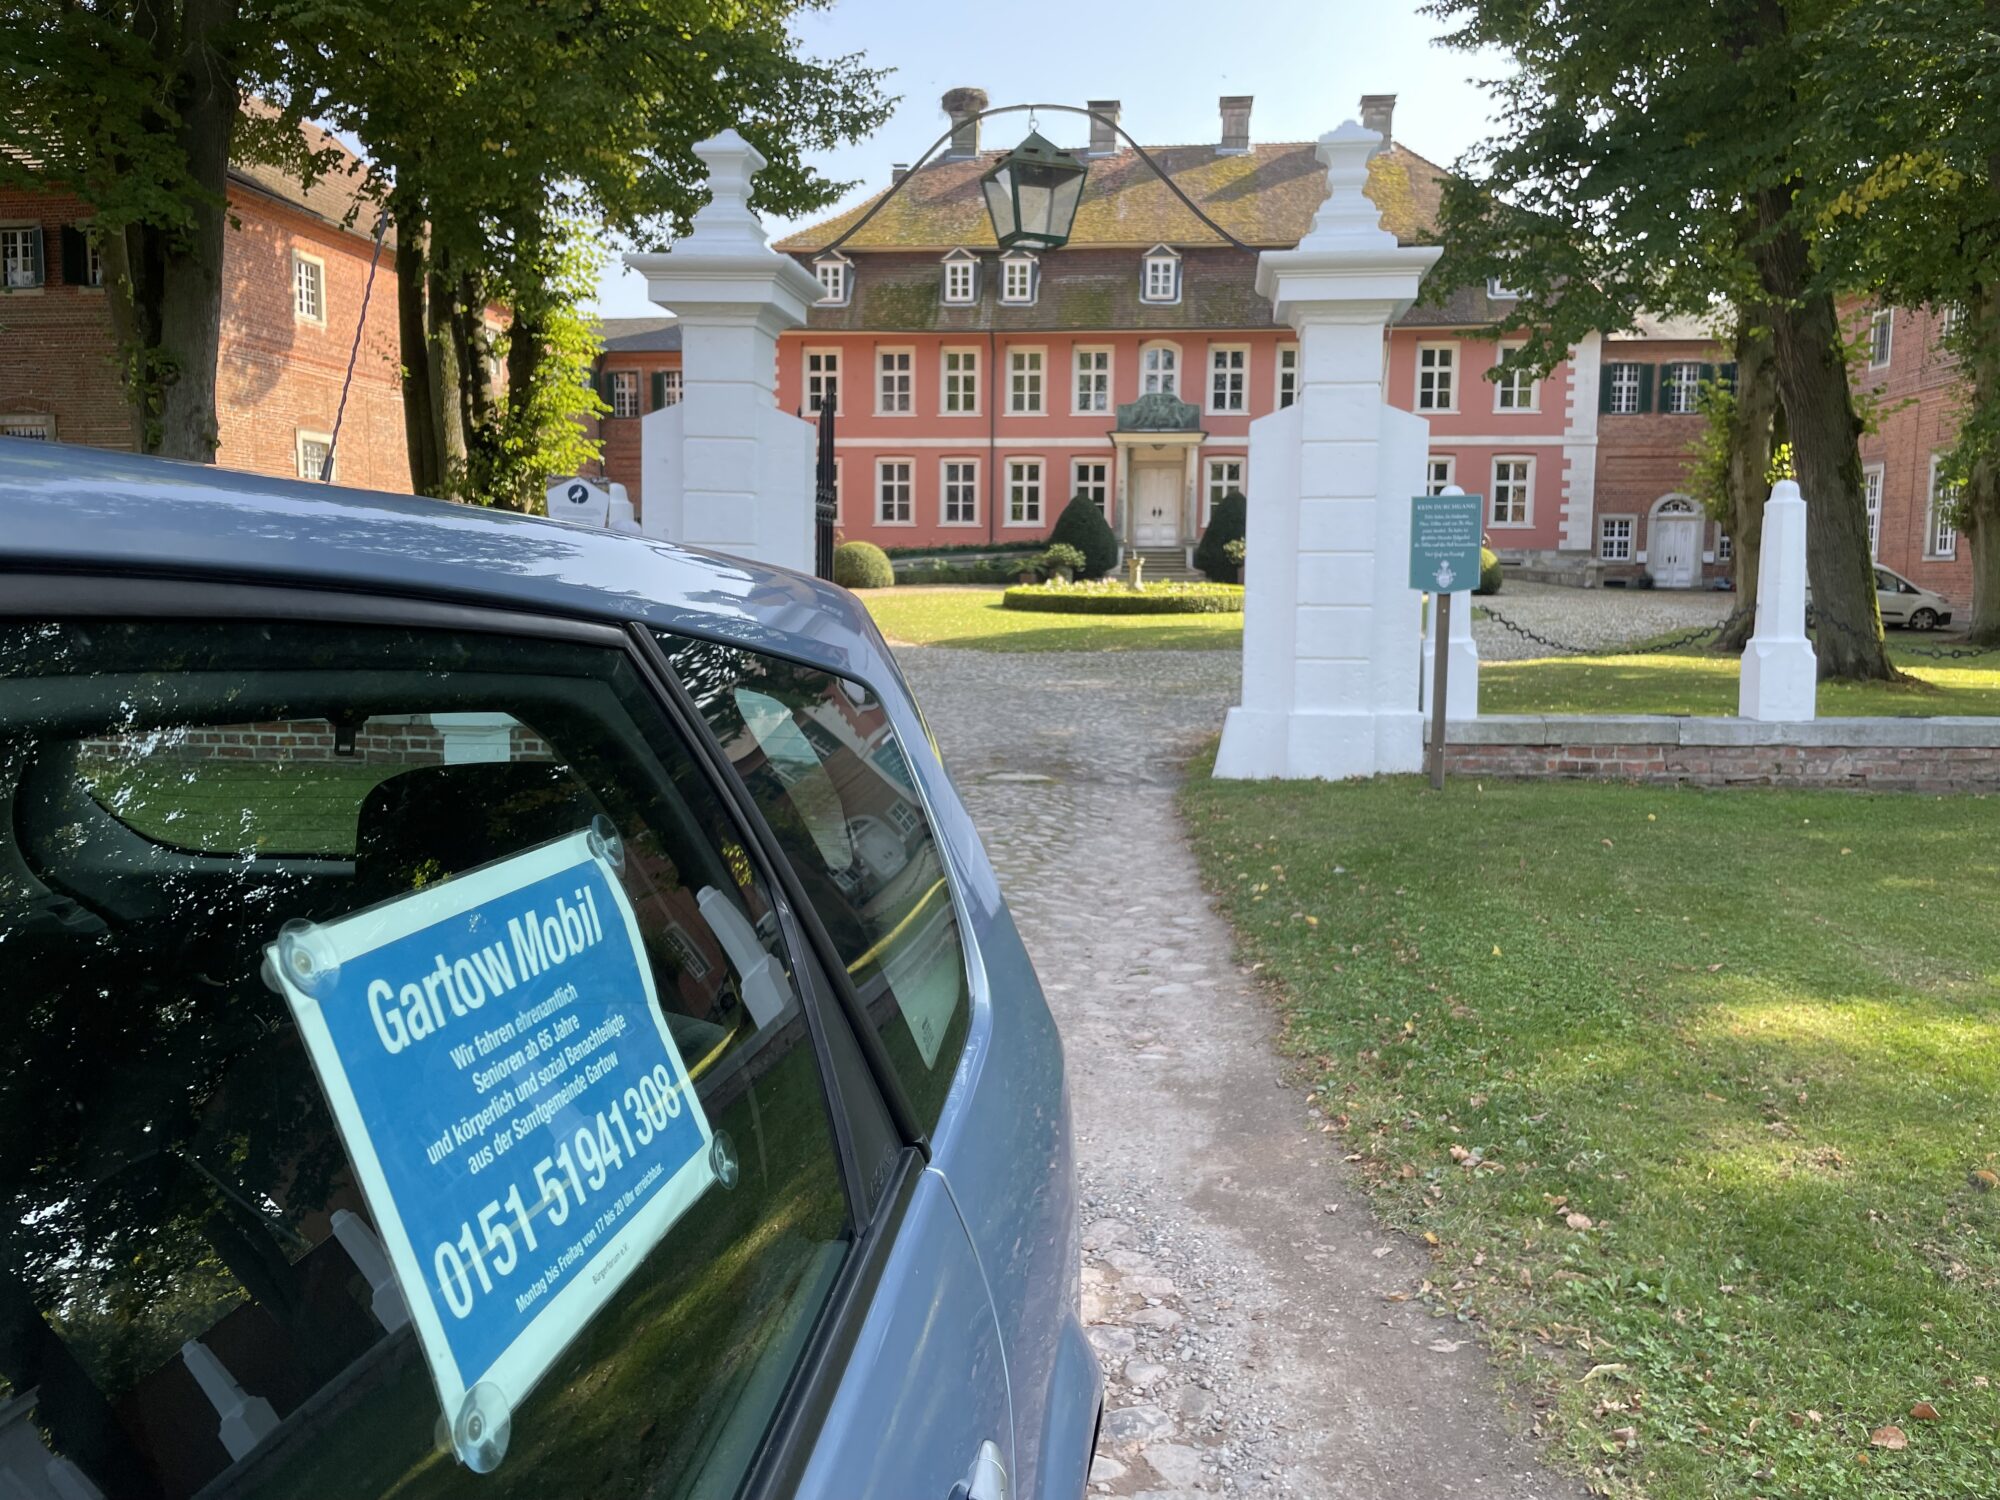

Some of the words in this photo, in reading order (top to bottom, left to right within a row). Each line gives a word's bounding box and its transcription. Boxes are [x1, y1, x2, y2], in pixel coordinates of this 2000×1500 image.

[367, 941, 517, 1055] Gartow
[507, 885, 603, 982] Mobil
[449, 1043, 476, 1070] Wir
[474, 1022, 516, 1056] fahren
[515, 982, 579, 1033] ehrenamtlich
[426, 1129, 454, 1165] und
[451, 1089, 516, 1146] körperlich
[514, 1072, 539, 1102] und
[537, 1051, 568, 1086] sozial
[564, 1013, 627, 1066] Benachteiligte
[468, 1145, 494, 1175] aus
[493, 1129, 514, 1155] der
[511, 1073, 588, 1140] Samtgemeinde
[584, 1050, 619, 1084] Gartow
[472, 1050, 526, 1094] Senioren
[525, 1038, 540, 1061] ab
[537, 1028, 553, 1051] 65
[552, 1014, 580, 1042] Jahre
[434, 1183, 538, 1319] 0151
[533, 1063, 681, 1226] 51941308
[515, 1277, 547, 1313] Montag
[544, 1265, 560, 1284] bis
[557, 1241, 584, 1272] Freitag
[582, 1227, 597, 1247] von
[594, 1216, 605, 1235] 17
[603, 1209, 616, 1227] bis
[613, 1198, 625, 1217] 20
[622, 1188, 635, 1208] Uhr
[634, 1162, 665, 1196] erreichbar.
